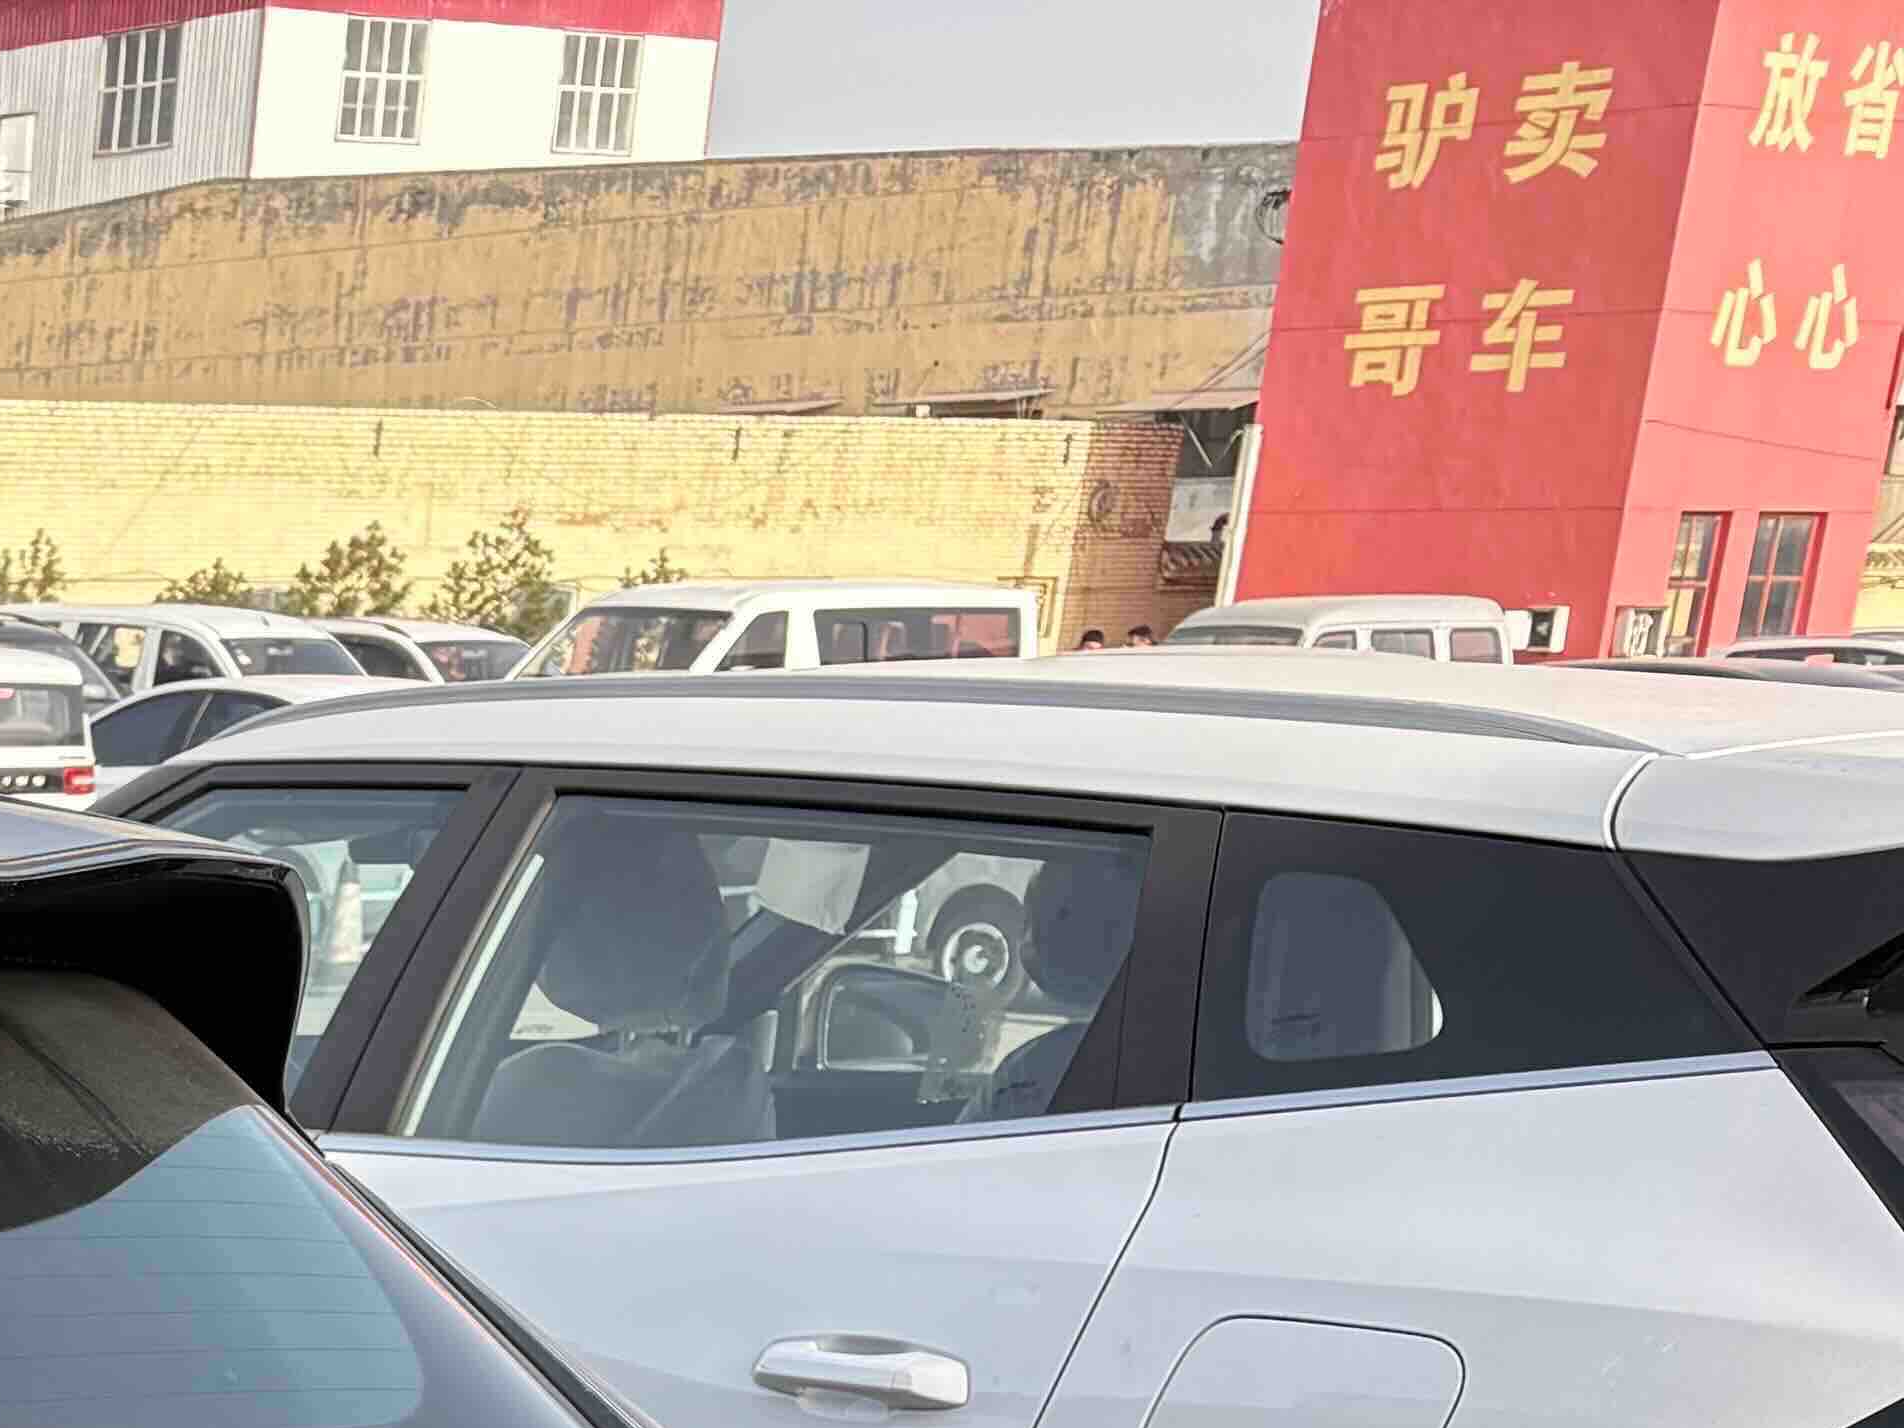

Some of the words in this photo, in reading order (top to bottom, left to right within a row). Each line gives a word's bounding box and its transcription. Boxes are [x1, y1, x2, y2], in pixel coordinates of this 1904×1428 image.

[1344, 72, 1480, 397] 驴哥
[1469, 61, 1613, 393] 卖车
[1711, 32, 1829, 366] 放心
[1794, 40, 1904, 369] 省心
